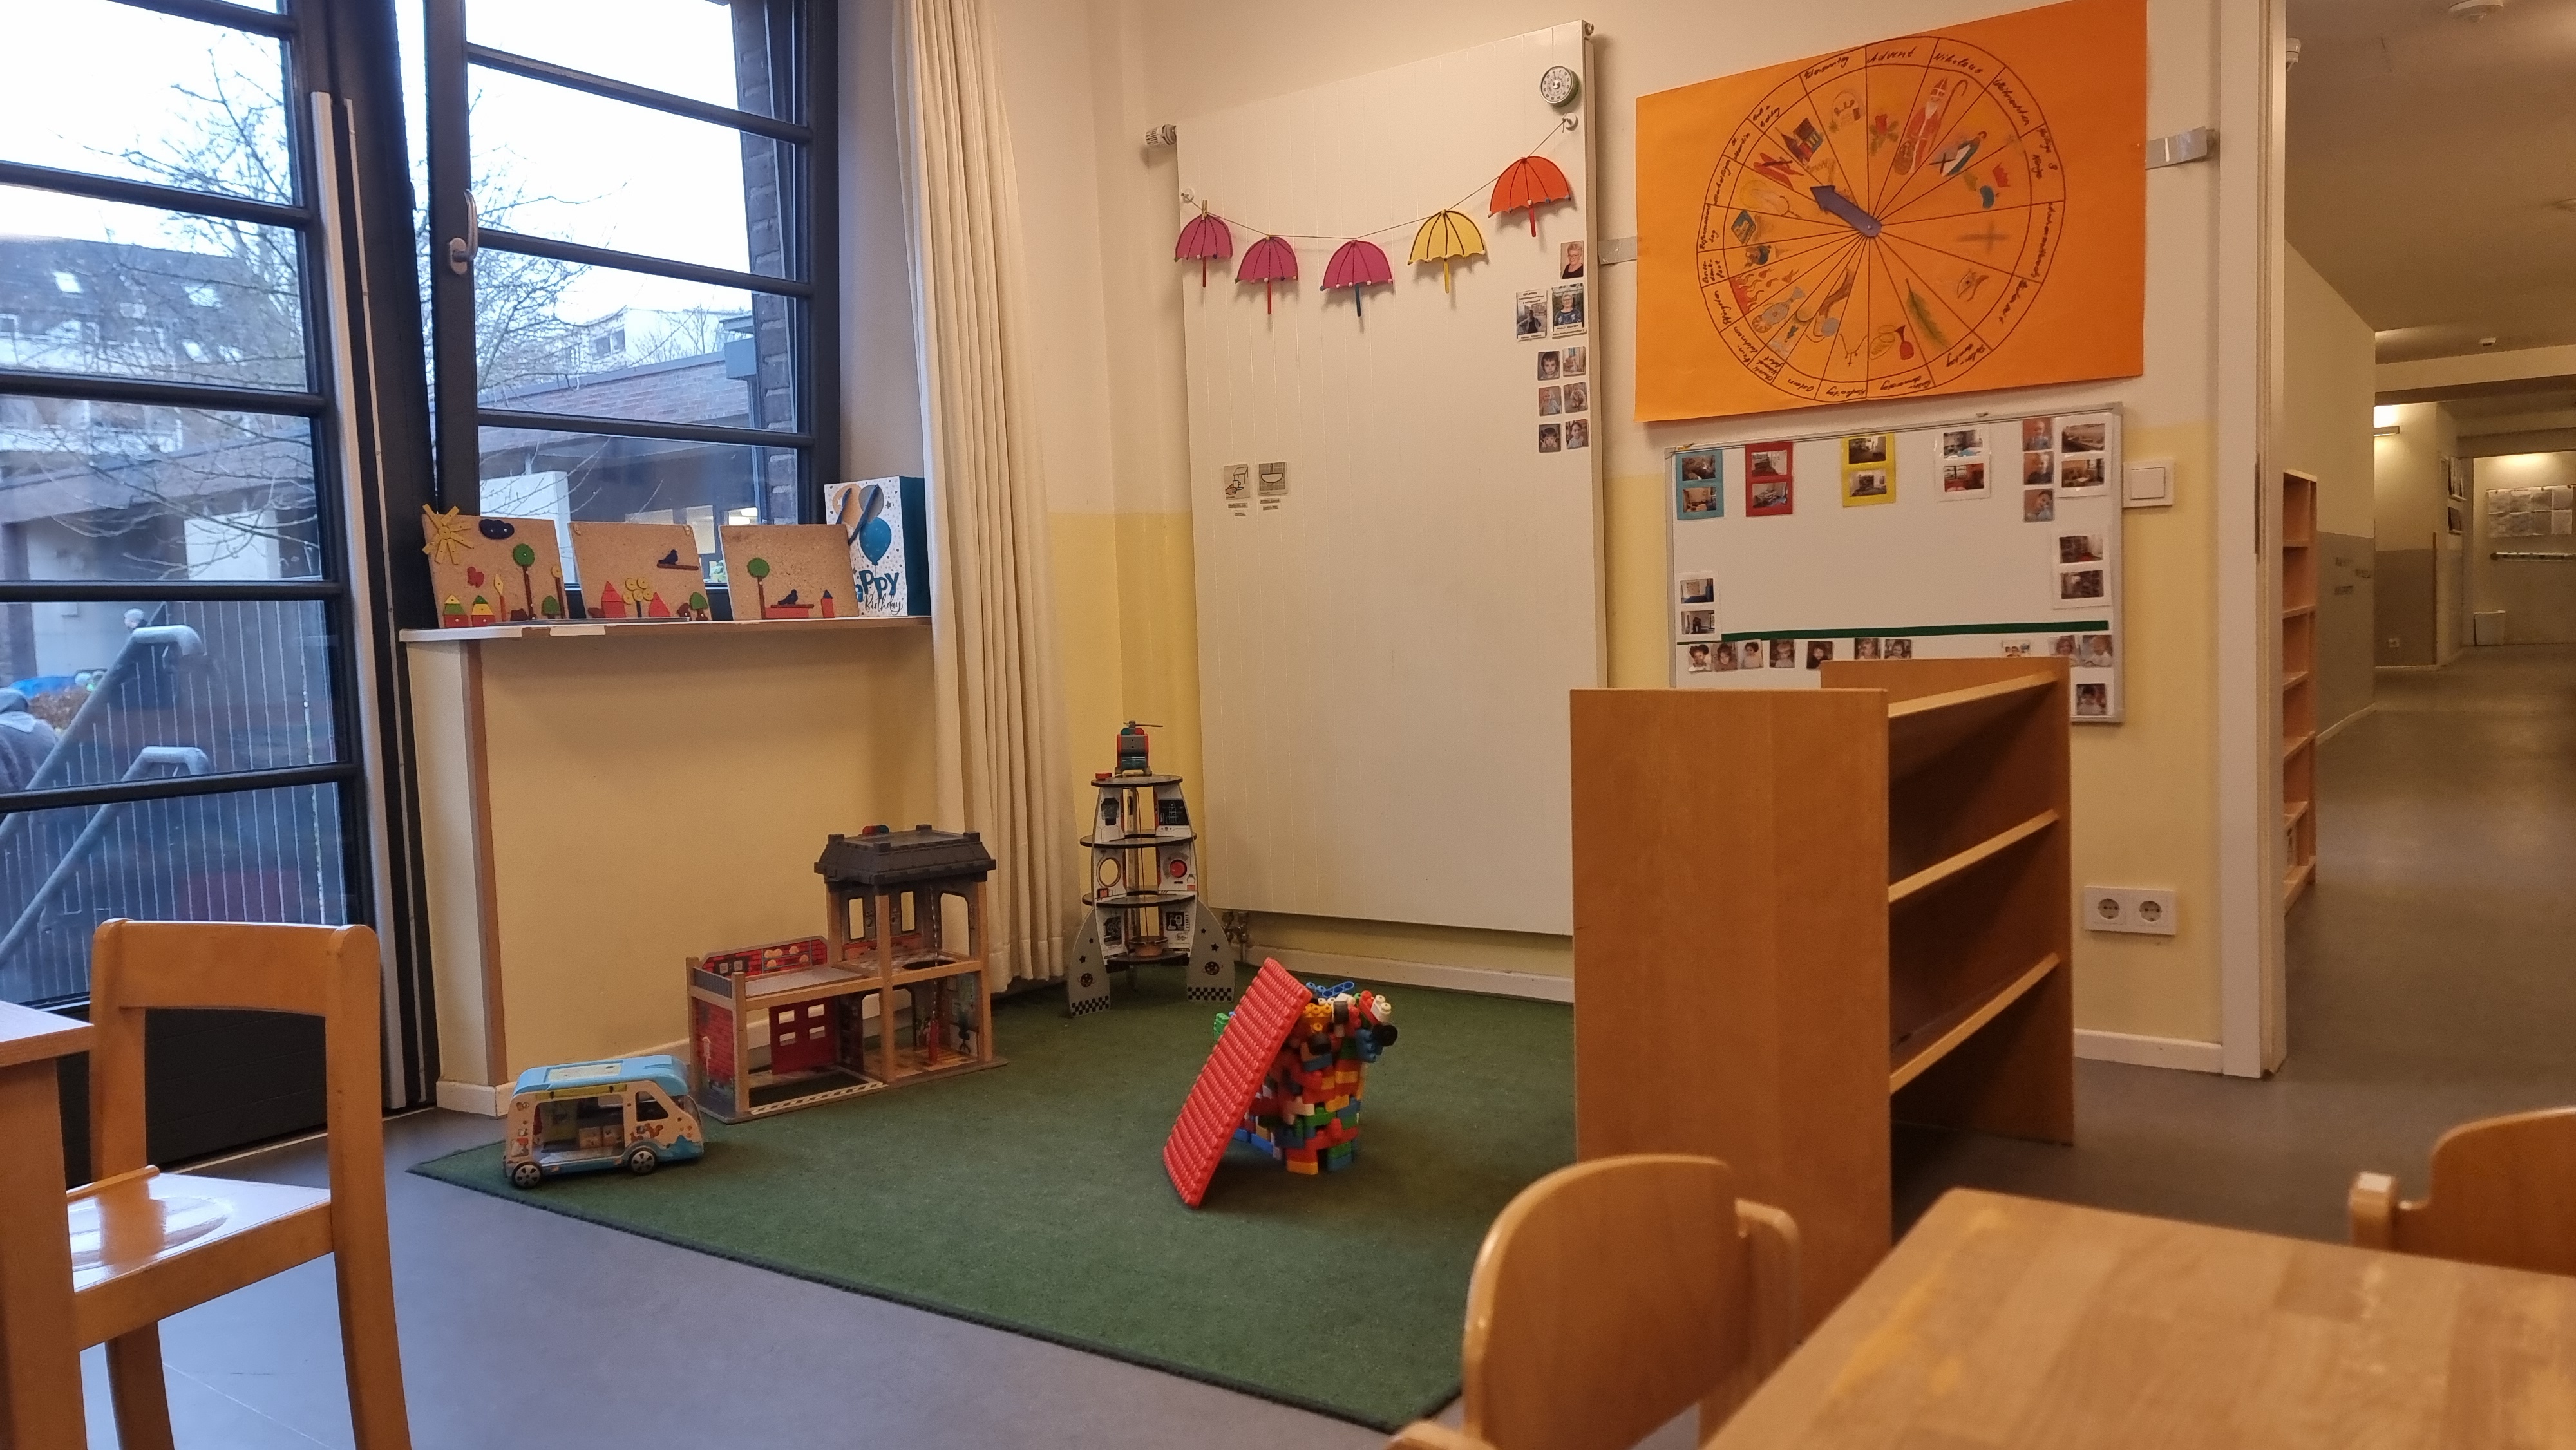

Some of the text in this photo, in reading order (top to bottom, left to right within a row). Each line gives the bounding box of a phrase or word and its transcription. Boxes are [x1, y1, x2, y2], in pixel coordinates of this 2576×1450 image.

[1867, 46, 1917, 63] Advent
[1933, 52, 1984, 73] Nikolaus
[1993, 79, 2030, 126] Weihnachten
[1714, 290, 1732, 325] Pfingsten
[1787, 378, 1814, 392] Ostern
[864, 593, 904, 616] Birthday
